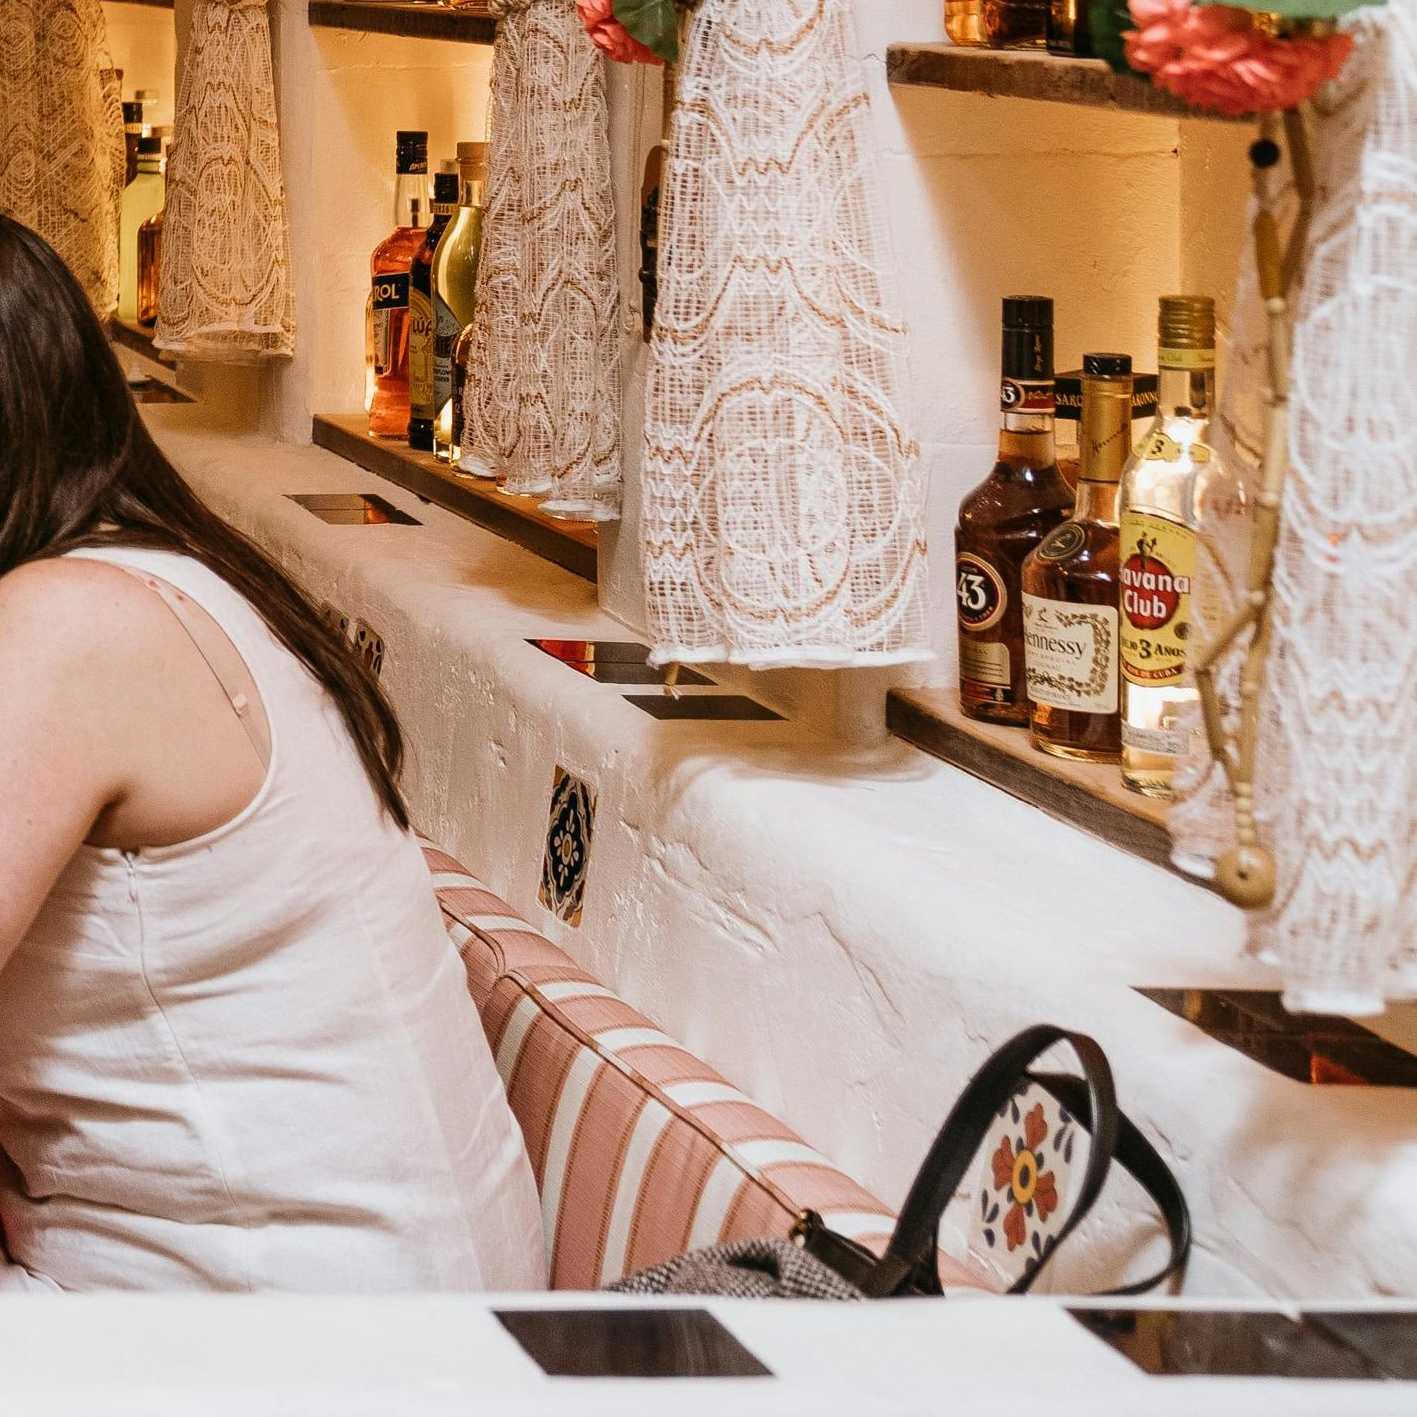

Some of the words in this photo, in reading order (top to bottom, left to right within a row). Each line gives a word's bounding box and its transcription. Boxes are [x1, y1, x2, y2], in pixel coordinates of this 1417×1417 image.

[957, 572, 987, 611] 43
[1124, 589, 1167, 619] Club
[1139, 638, 1152, 659] 3
